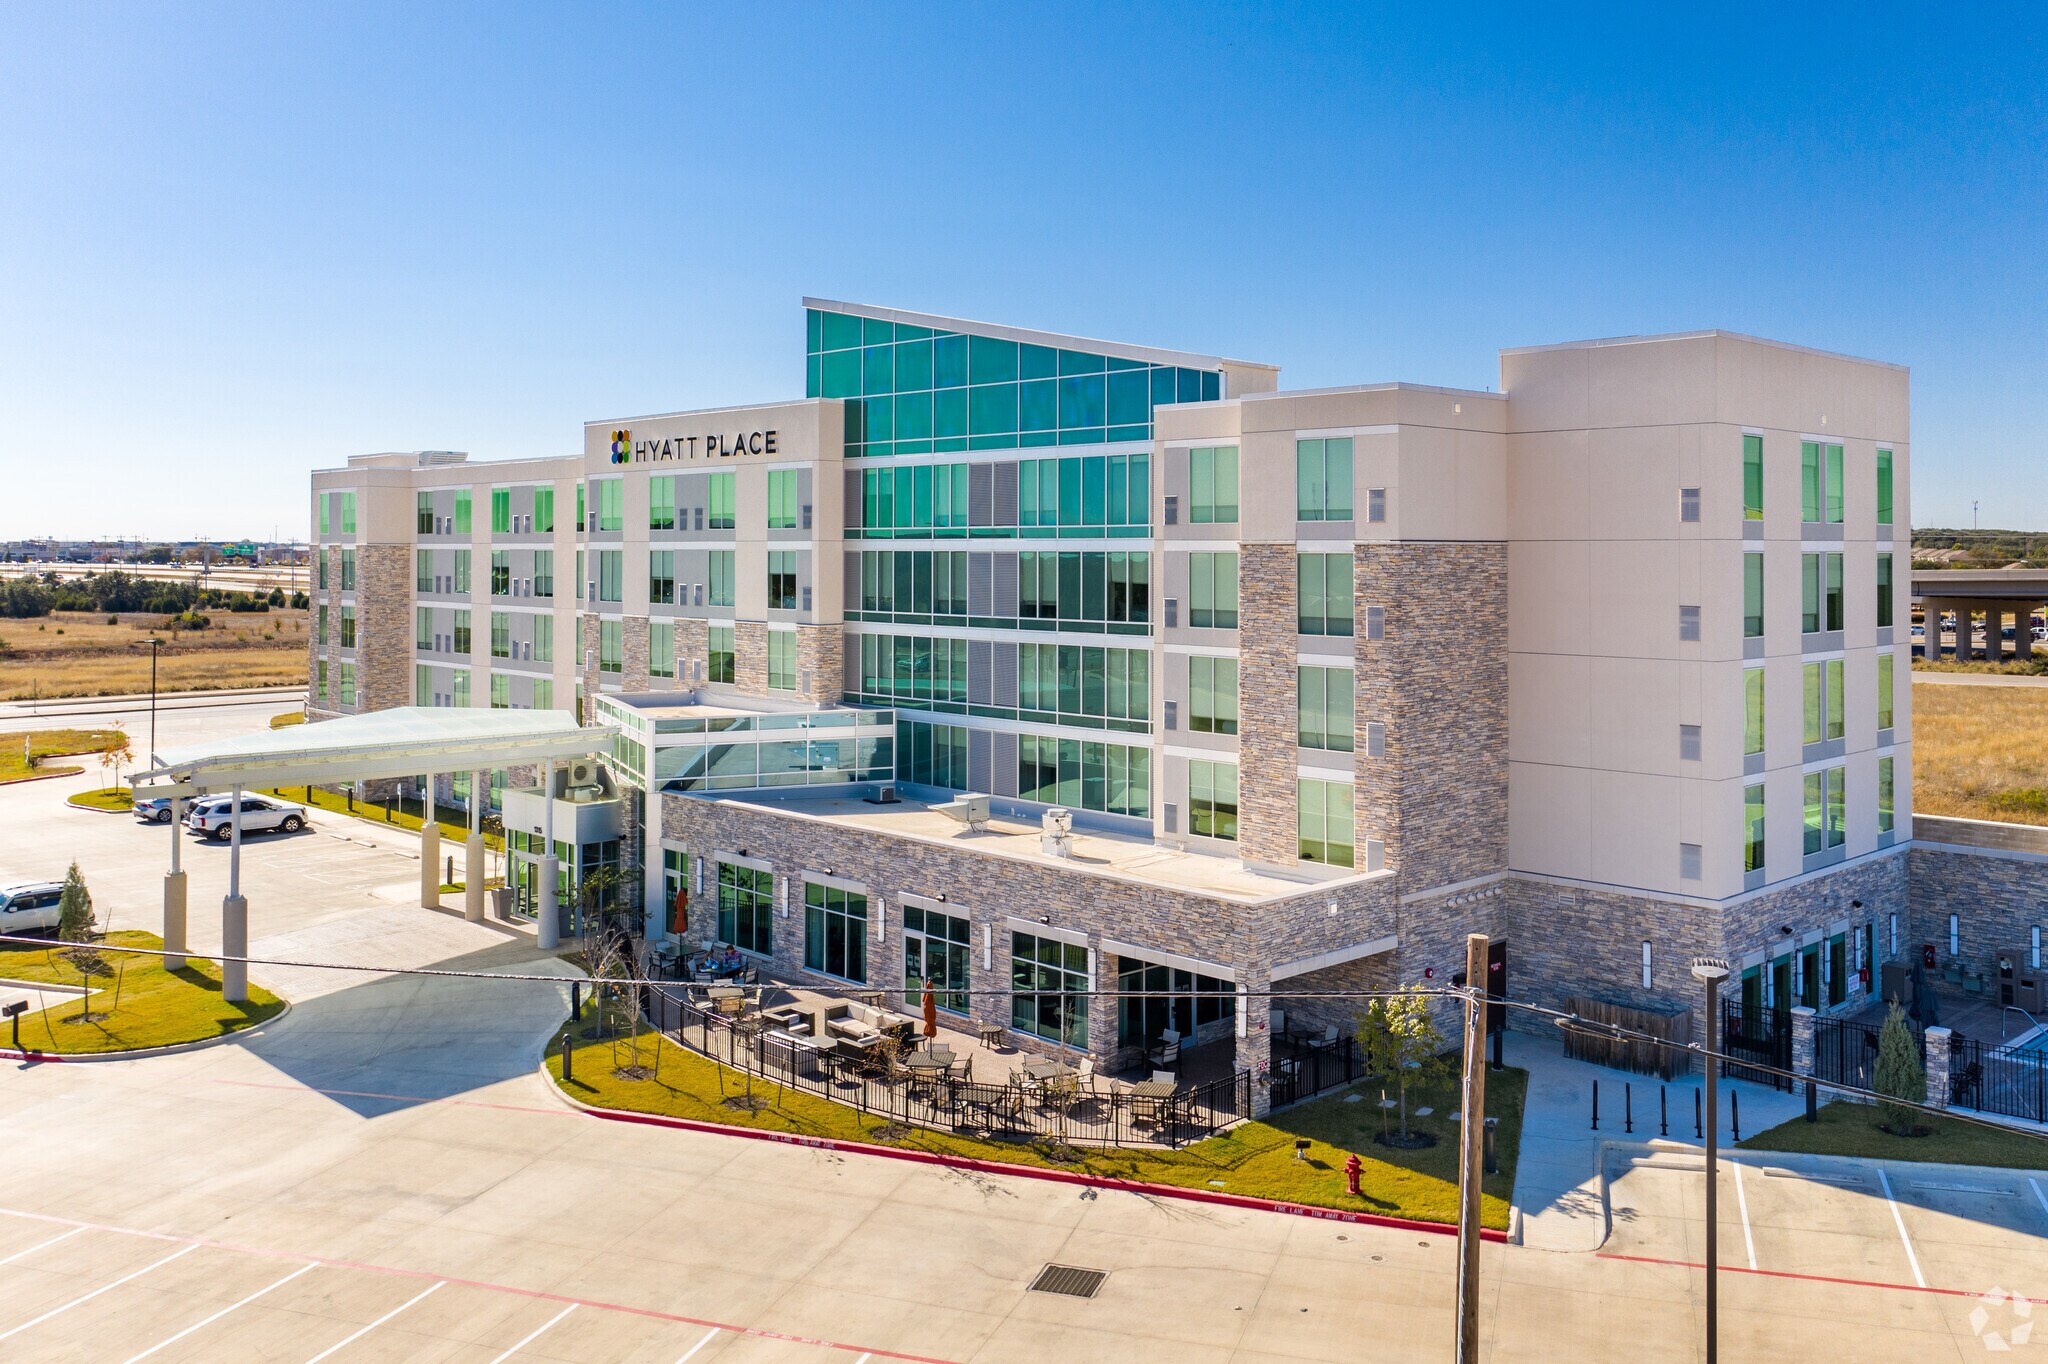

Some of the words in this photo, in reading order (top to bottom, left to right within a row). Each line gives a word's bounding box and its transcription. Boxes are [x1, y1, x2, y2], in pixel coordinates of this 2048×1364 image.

[636, 437, 697, 462] HYATT
[707, 431, 776, 457] PLACE
[1274, 1205, 1287, 1213] FIRE
[1289, 1207, 1304, 1215] LANE
[1311, 1210, 1322, 1218] TOW
[1325, 1212, 1339, 1220] AWAY
[1342, 1214, 1357, 1222] ZONE
